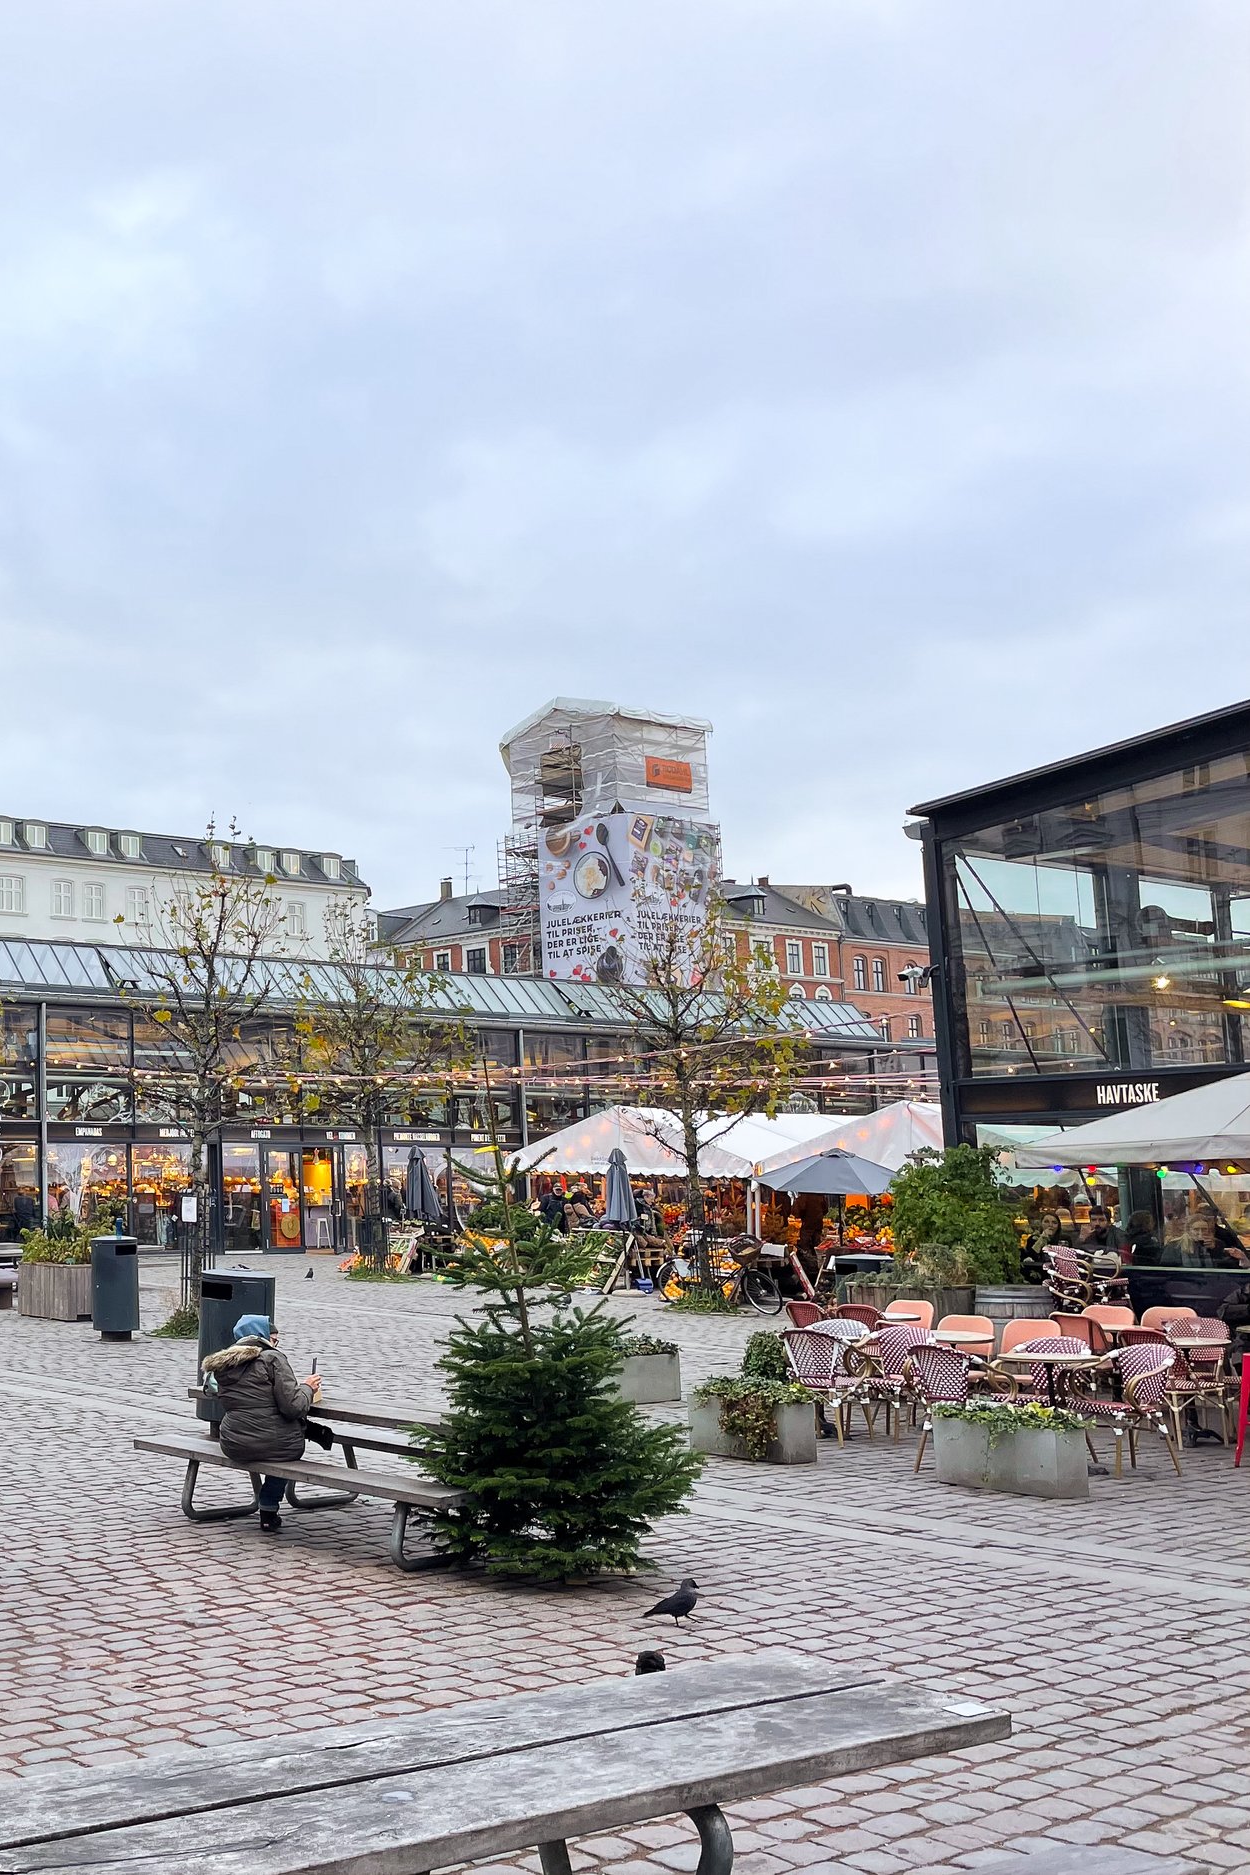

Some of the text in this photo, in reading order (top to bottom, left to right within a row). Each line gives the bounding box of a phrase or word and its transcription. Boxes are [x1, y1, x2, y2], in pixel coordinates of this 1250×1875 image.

[546, 910, 621, 929] JULELÆKKERIER
[546, 930, 560, 939] TIL
[547, 934, 599, 949] DER ER LIGE
[637, 932, 654, 941] DER
[547, 944, 602, 959] TIL AT SPISE
[1096, 1082, 1160, 1105] HAVTASKE
